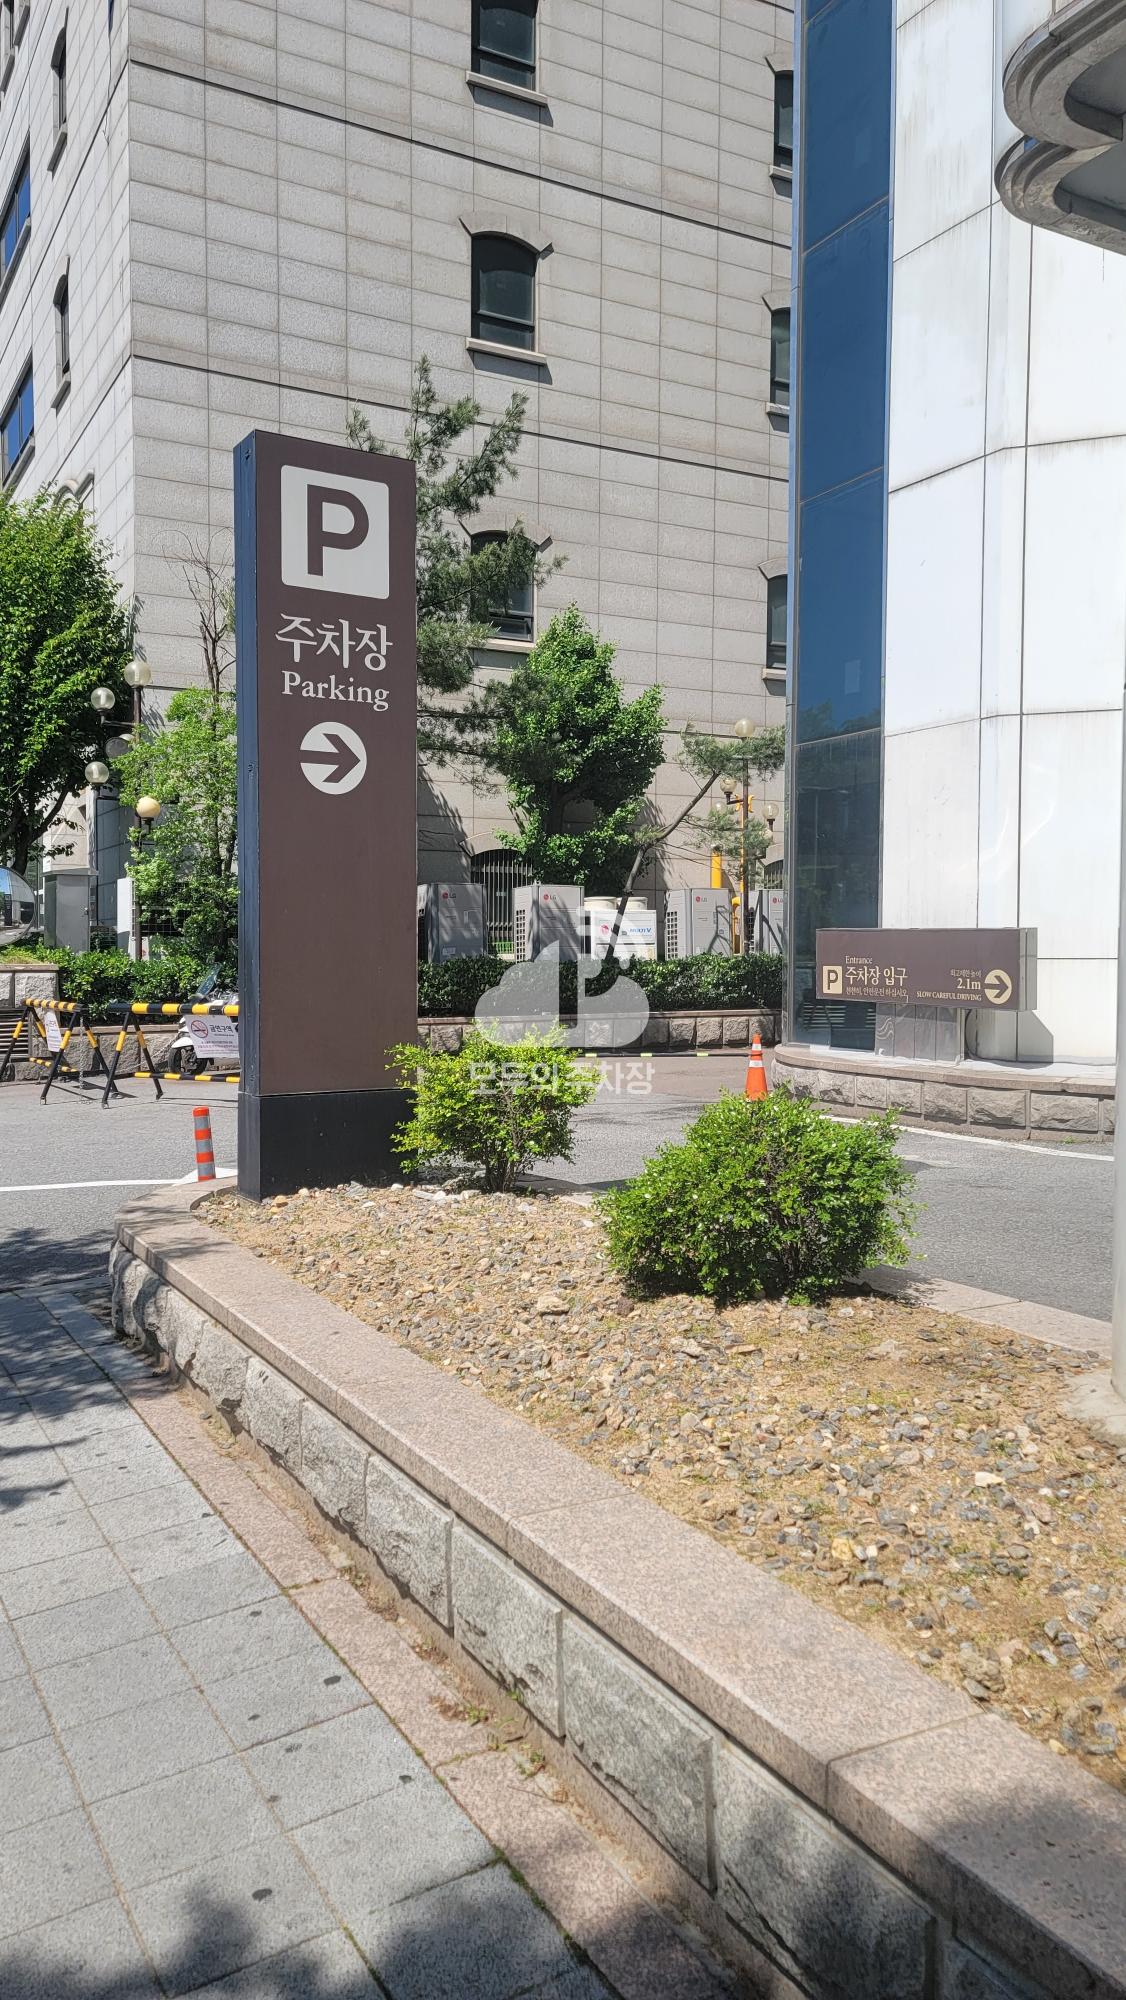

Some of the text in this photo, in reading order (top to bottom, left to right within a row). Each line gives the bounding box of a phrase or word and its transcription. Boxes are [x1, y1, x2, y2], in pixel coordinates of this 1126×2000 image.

[306, 484, 370, 577] P
[275, 613, 393, 672] 주차장
[281, 670, 390, 712] Parking
[845, 955, 873, 965] Entrance
[827, 969, 839, 991] P
[845, 965, 908, 987] 주차장 입구
[956, 977, 981, 990] 2.1m
[916, 990, 982, 1002] SLOW CAREFUL DRIVING
